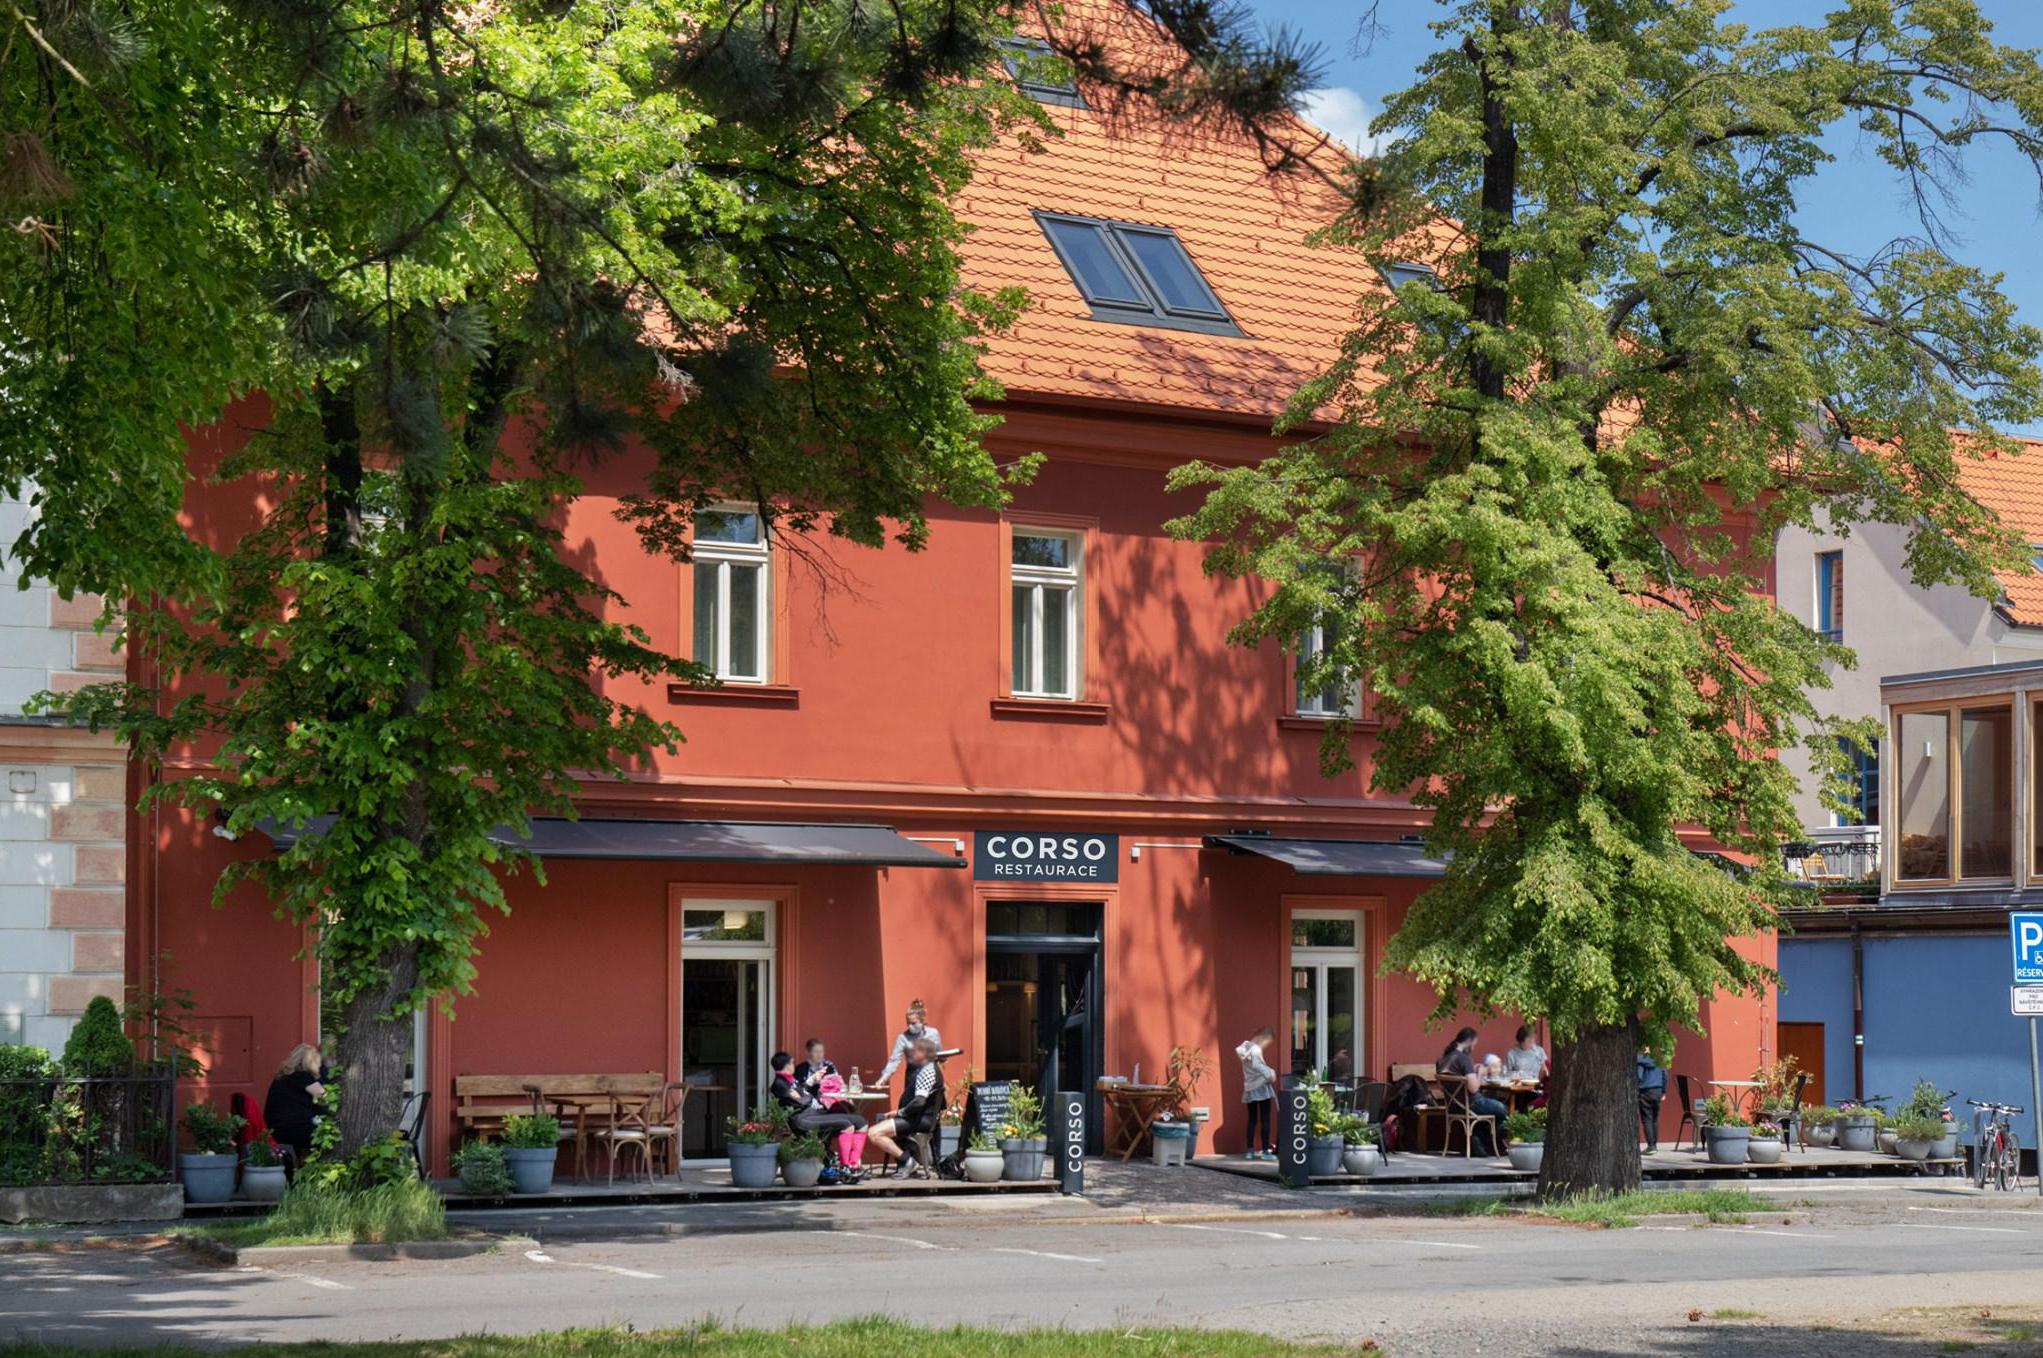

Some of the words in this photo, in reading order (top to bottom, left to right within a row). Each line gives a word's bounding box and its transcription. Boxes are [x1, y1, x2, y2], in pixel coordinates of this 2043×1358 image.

[987, 836, 1106, 861] CORSO
[994, 863, 1098, 877] RESTAURACE
[2020, 922, 2043, 961] P
[1068, 1102, 1082, 1173] CORSO
[1293, 1096, 1307, 1165] CORSO
